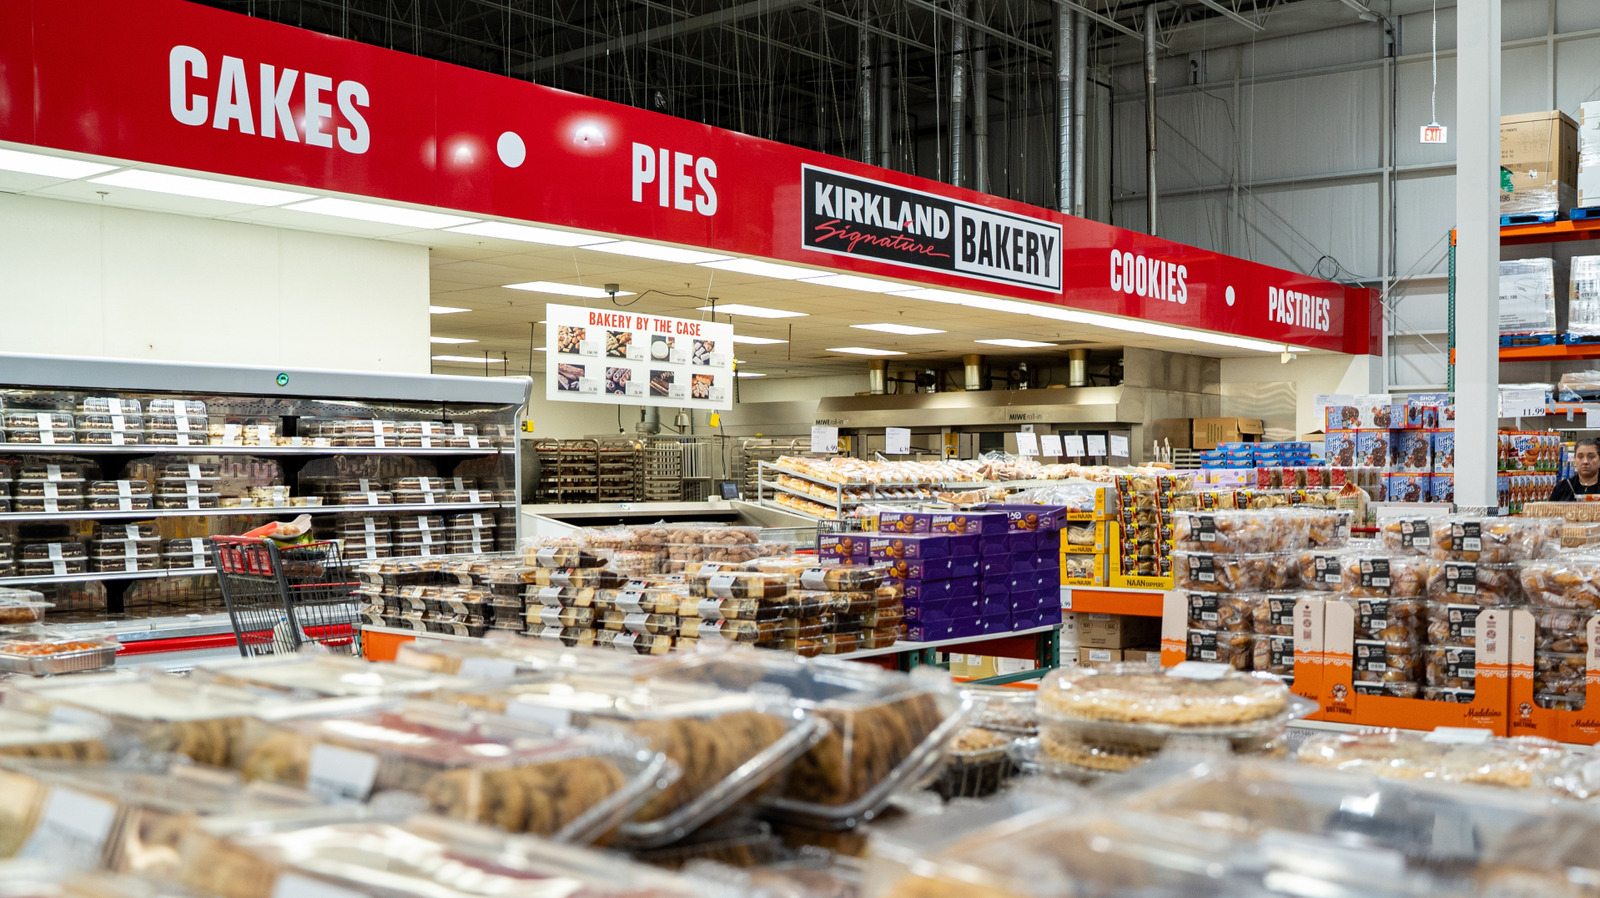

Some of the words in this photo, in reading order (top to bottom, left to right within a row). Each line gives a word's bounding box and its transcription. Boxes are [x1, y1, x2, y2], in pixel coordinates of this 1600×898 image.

[169, 44, 370, 154] CAKES
[1424, 128, 1442, 141] EXIT
[632, 141, 717, 216] PIES
[815, 181, 950, 240] KIRKLAND
[961, 215, 1054, 278] BAKERY
[815, 220, 950, 258] Signature
[1110, 249, 1187, 304] COOKIES
[1268, 286, 1330, 332] PASTRIES
[589, 311, 632, 329] BAKERY
[636, 317, 649, 331] BY
[653, 319, 672, 333] THE
[676, 321, 701, 337] CASE
[1523, 408, 1545, 416] 11.99
[1360, 433, 1376, 448] Little
[1365, 440, 1382, 451] Bites
[1515, 438, 1530, 449] Little
[1519, 444, 1535, 453] Bites
[1126, 579, 1146, 587] NAAN
[1464, 708, 1502, 718] Madeleine
